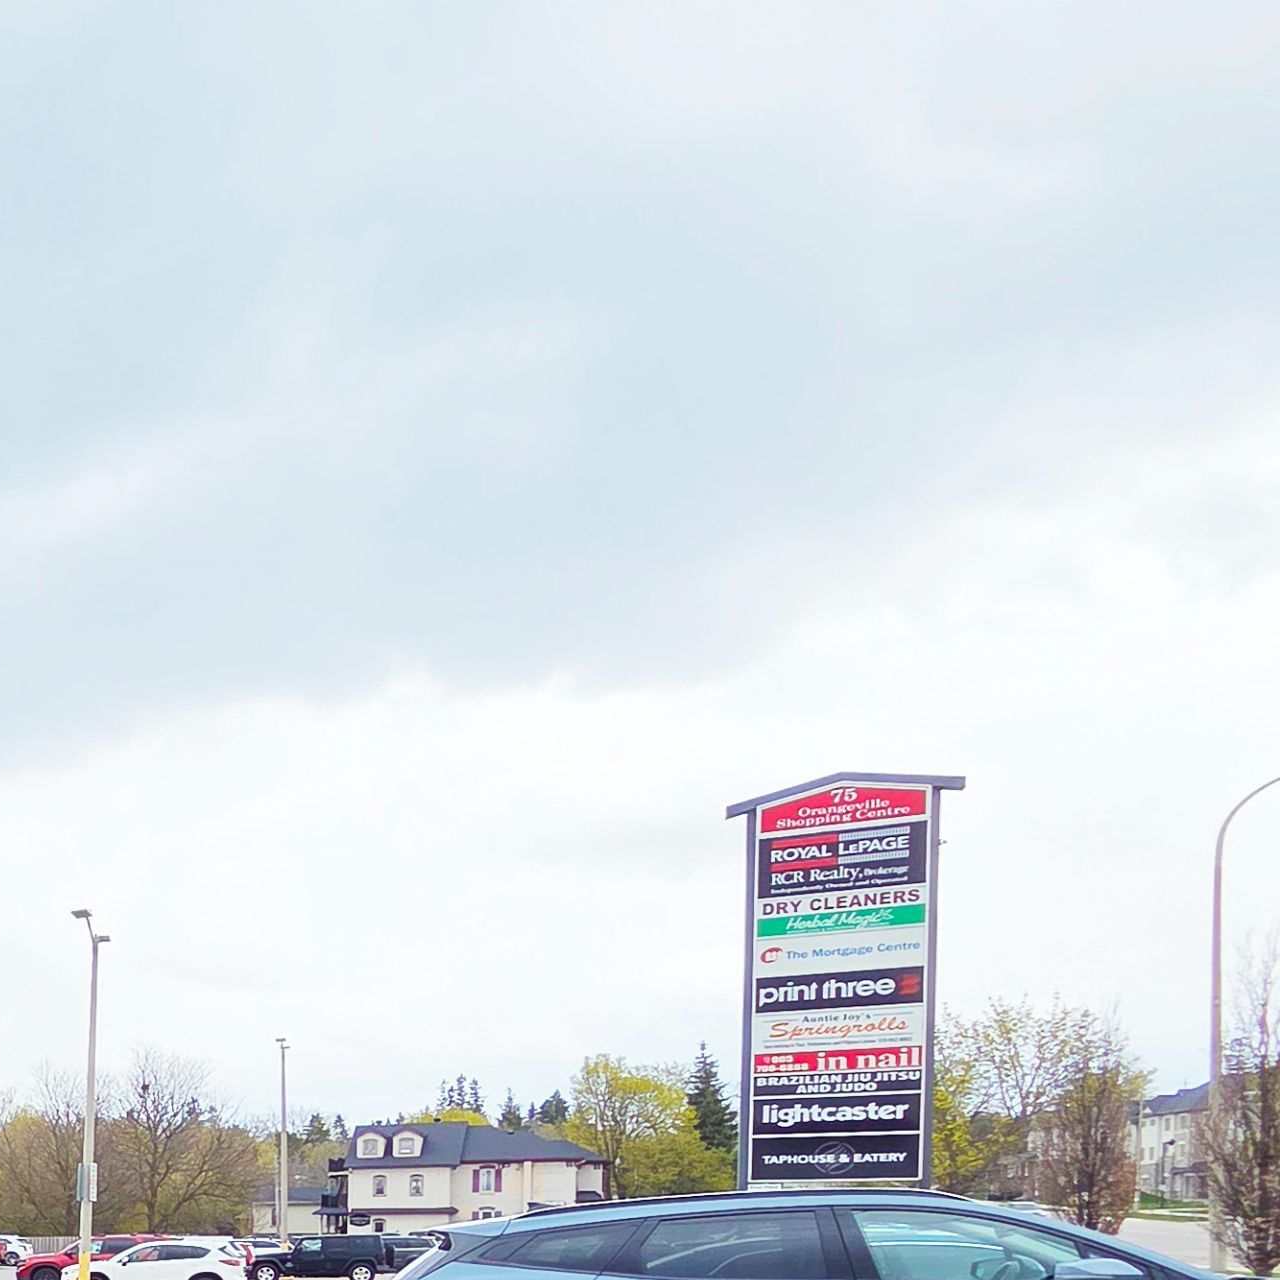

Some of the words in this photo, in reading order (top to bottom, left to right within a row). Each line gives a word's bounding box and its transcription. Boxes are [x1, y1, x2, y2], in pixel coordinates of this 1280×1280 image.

[830, 787, 857, 803] 75
[798, 798, 890, 817] Orangeville
[776, 812, 852, 829] Shopping
[855, 806, 911, 819] Centre
[771, 844, 833, 863] ROYAL
[771, 870, 805, 886] RCR
[762, 900, 802, 916] DRY
[810, 889, 921, 911] CLEANERS
[786, 913, 837, 930] Herbal
[786, 950, 809, 960] The
[812, 946, 873, 958] Mortgage
[877, 941, 921, 953] Centre
[758, 980, 818, 1007] print
[822, 977, 896, 1000] three
[802, 1014, 839, 1023] Auntie
[843, 1013, 872, 1022] Joy's
[769, 1017, 909, 1040] Springrolls
[817, 1052, 848, 1070] in
[856, 1046, 921, 1069] nail
[756, 1073, 842, 1087] BRAZILIAN
[845, 1072, 872, 1083] JIU
[874, 1070, 921, 1082] JITSU
[796, 1084, 830, 1094] AND
[833, 1082, 878, 1093] JUDO
[761, 1102, 910, 1128] lightcaster
[761, 1153, 836, 1165] TAPHOUSE
[838, 1152, 851, 1164] &
[853, 1152, 908, 1163] EATERY
